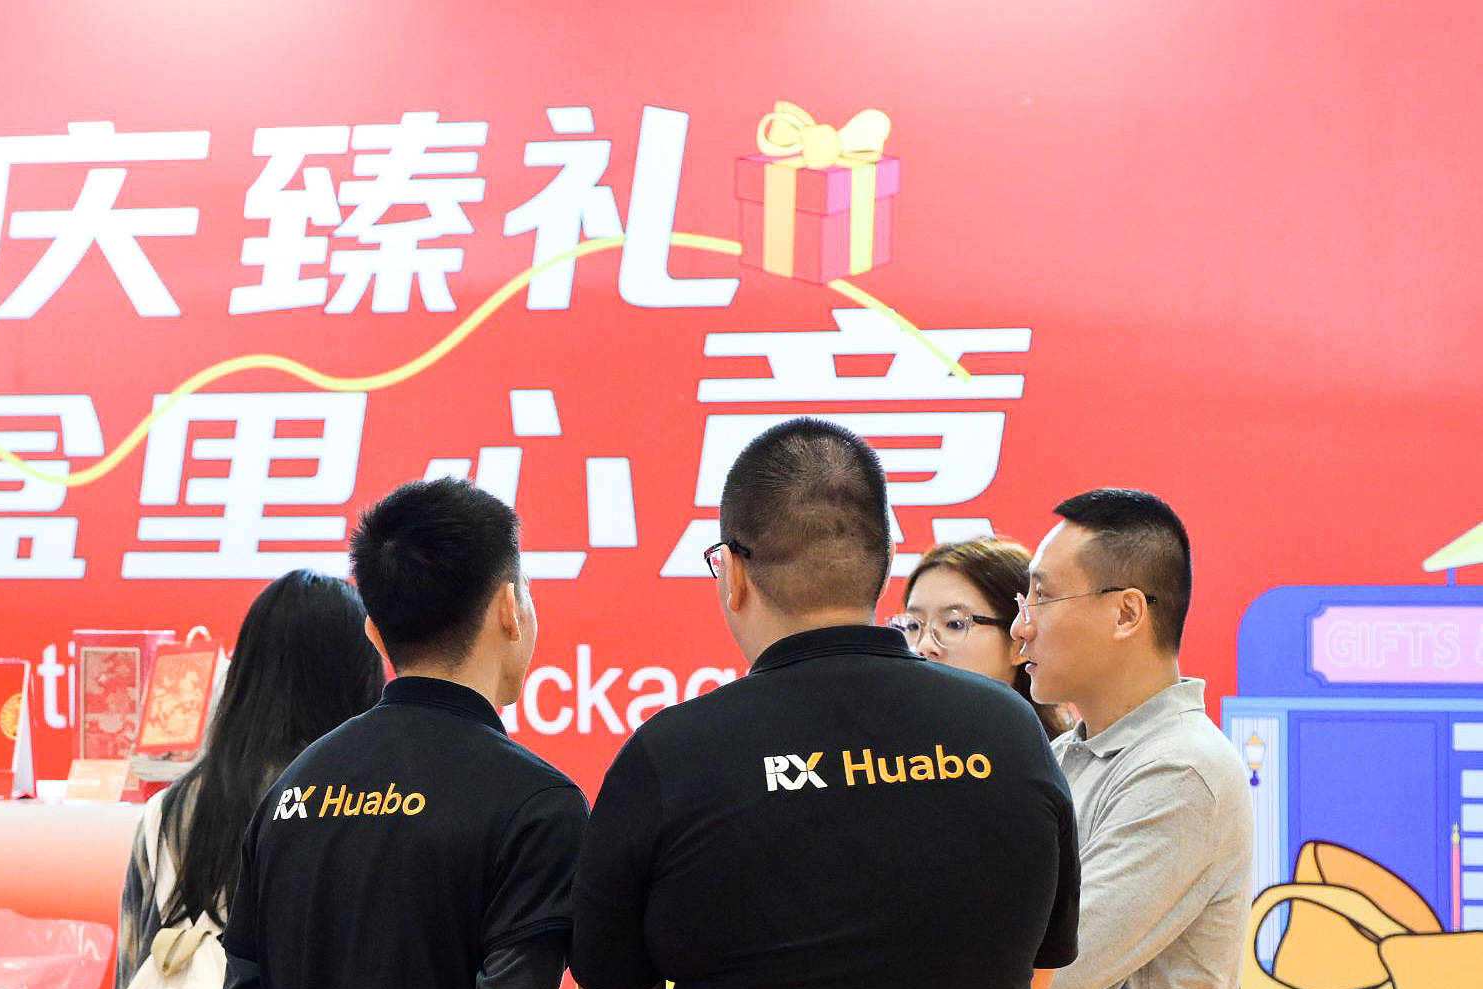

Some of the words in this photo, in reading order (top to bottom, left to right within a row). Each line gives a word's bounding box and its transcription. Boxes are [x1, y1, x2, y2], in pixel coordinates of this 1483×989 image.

[1324, 620, 1461, 670] GIFTS
[763, 751, 829, 792] RX
[841, 744, 993, 786] Huabo
[272, 785, 317, 821] RX
[318, 782, 427, 818] Huabo
